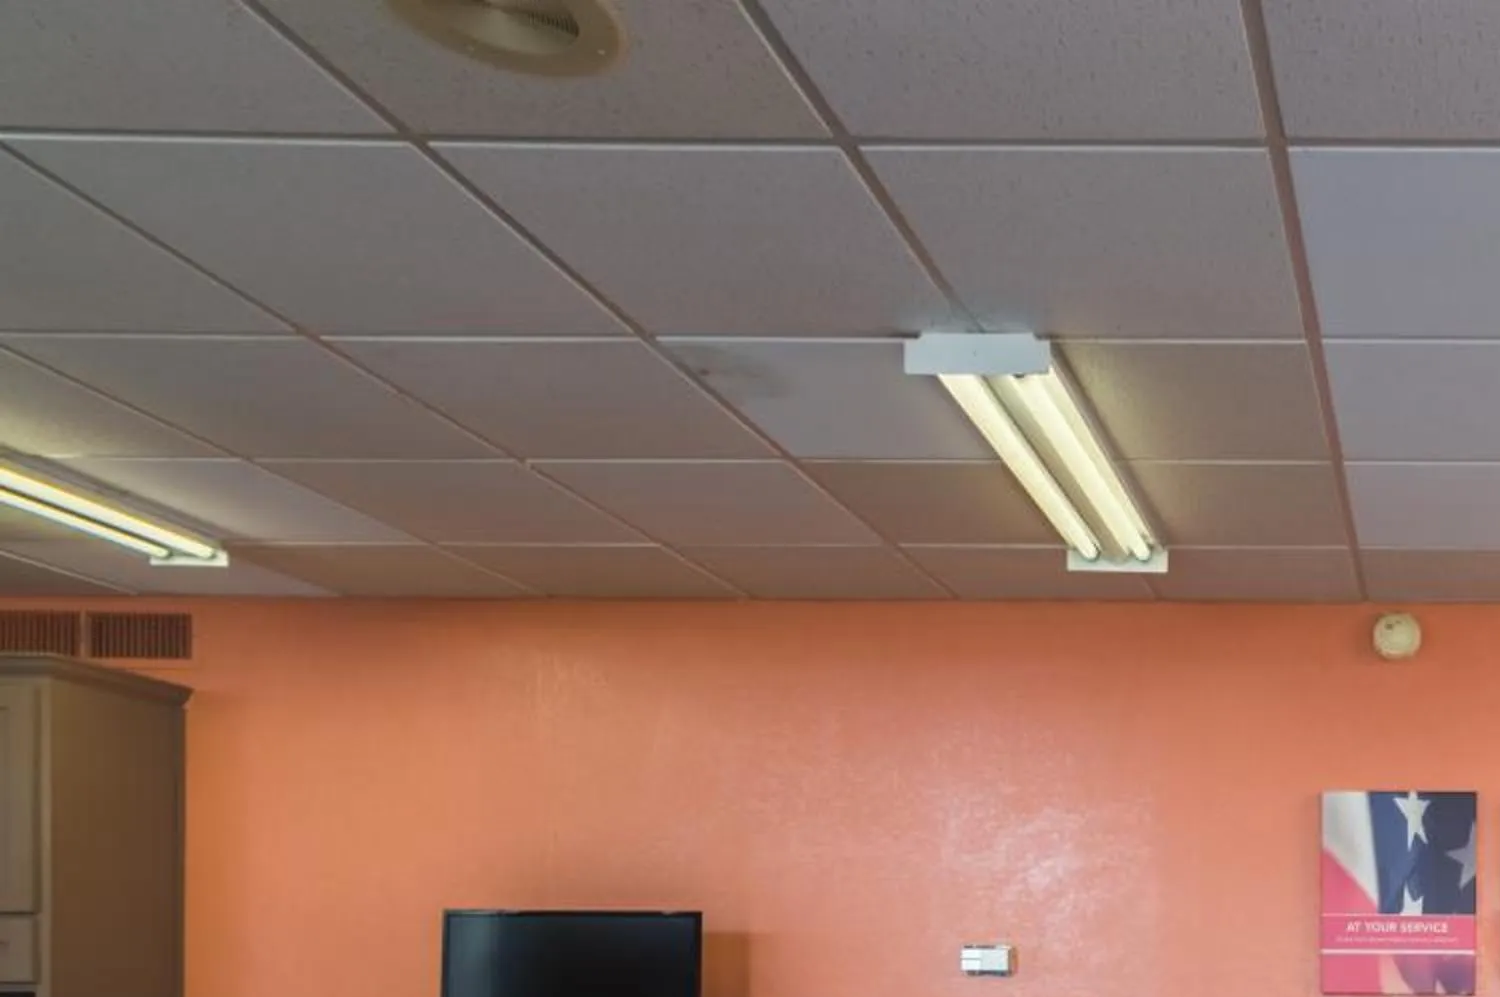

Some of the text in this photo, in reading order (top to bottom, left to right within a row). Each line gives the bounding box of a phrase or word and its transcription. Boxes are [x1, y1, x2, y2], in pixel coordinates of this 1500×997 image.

[1346, 921, 1448, 933] AT YOUR SERVICE
